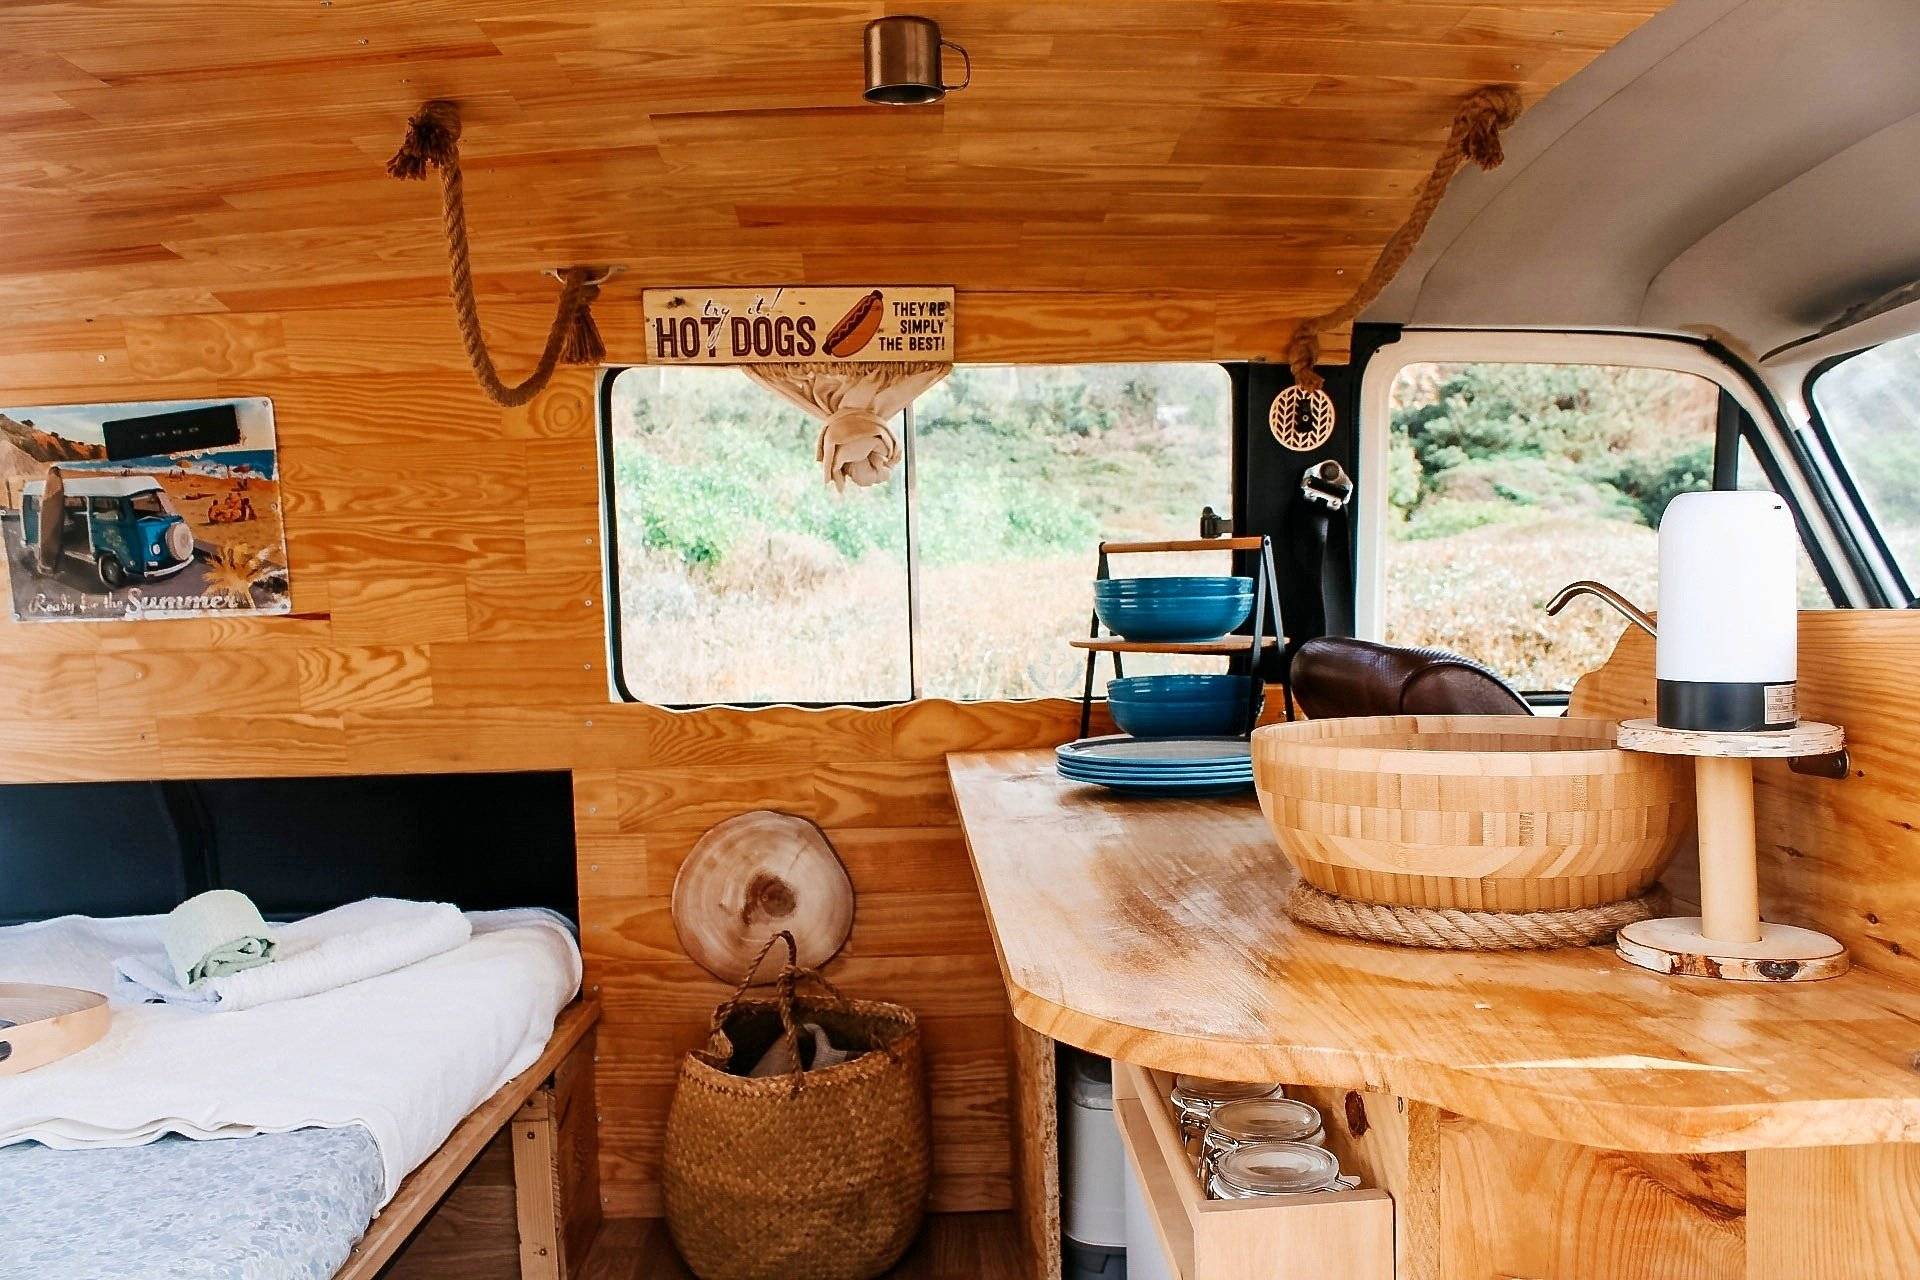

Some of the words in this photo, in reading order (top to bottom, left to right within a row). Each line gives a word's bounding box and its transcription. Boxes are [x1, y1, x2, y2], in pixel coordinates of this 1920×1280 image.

[703, 299, 730, 349] try
[747, 287, 784, 317] it!
[892, 301, 946, 317] THEY'RE
[655, 316, 722, 358] HOT
[731, 316, 816, 358] DOGS
[900, 319, 945, 335] SIMPLY
[879, 337, 902, 351] THE
[908, 336, 946, 352] BEST!
[28, 593, 75, 613] Ready
[79, 592, 99, 610] for
[103, 591, 123, 609] the
[125, 587, 239, 613] Summer
